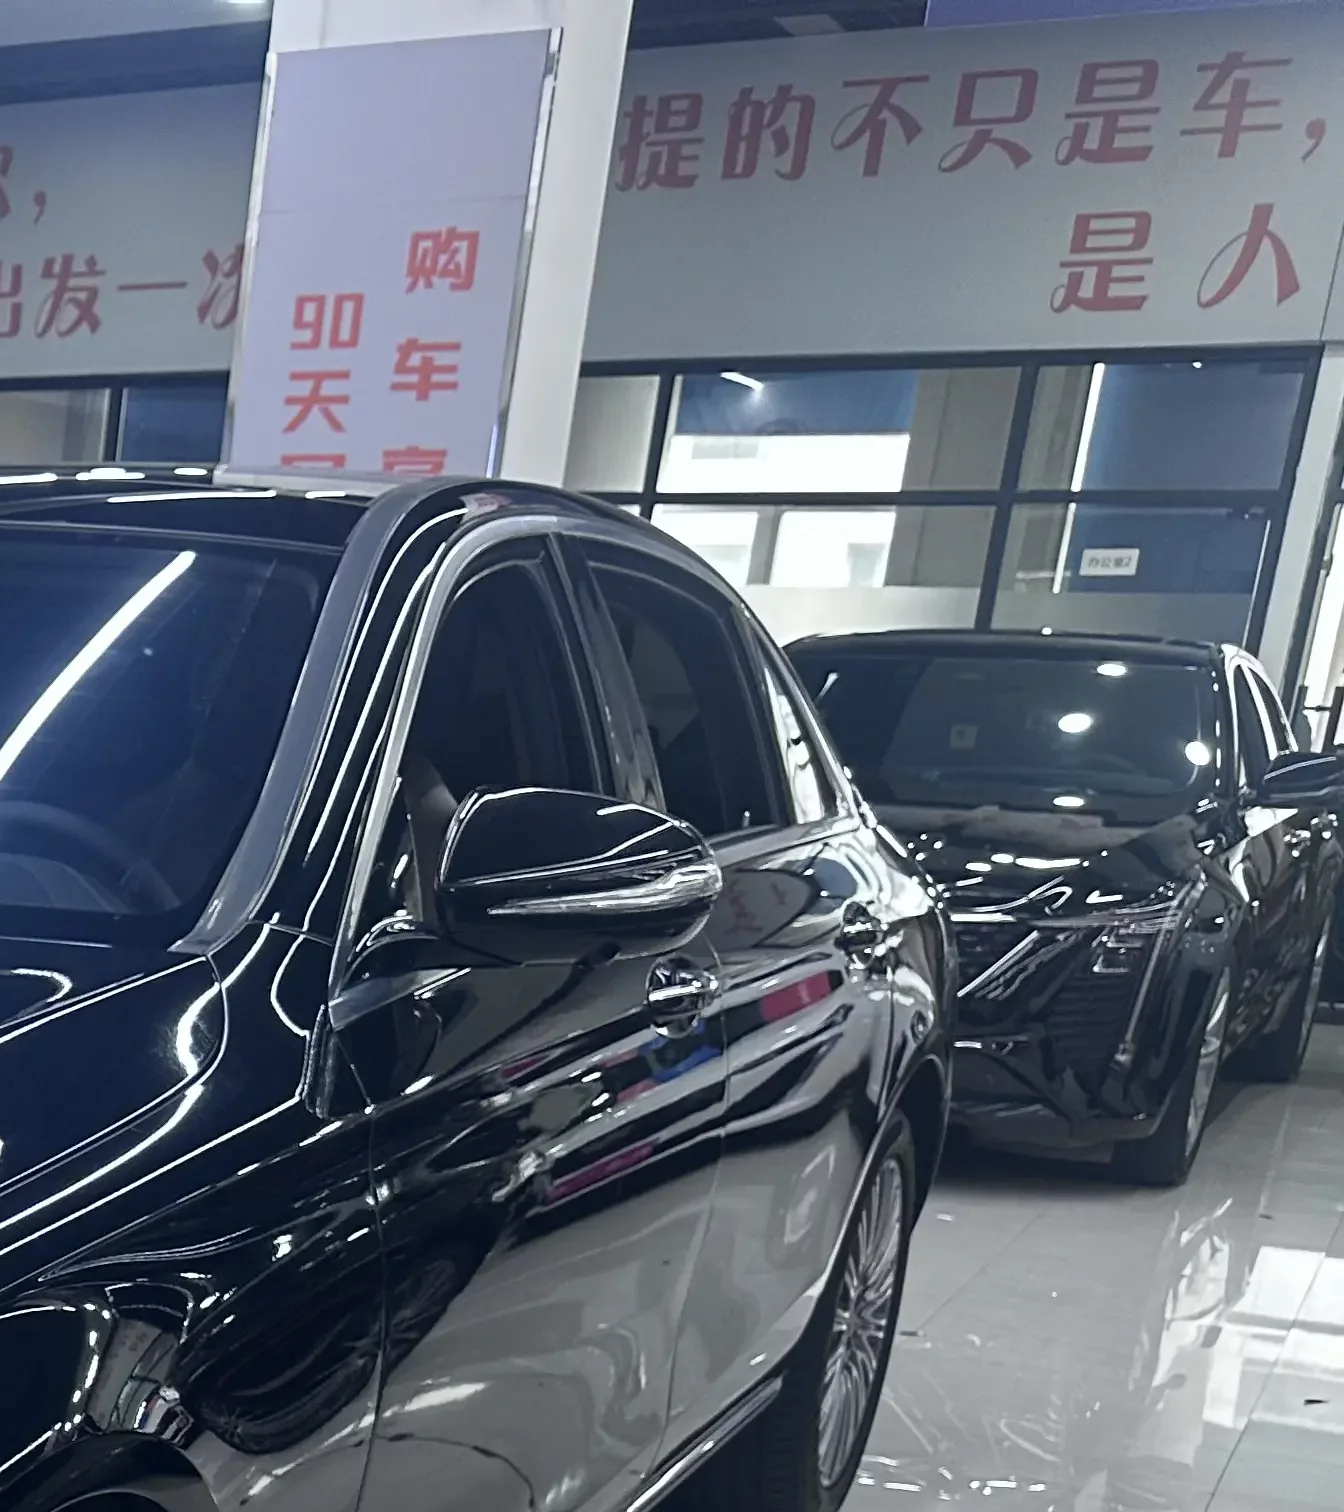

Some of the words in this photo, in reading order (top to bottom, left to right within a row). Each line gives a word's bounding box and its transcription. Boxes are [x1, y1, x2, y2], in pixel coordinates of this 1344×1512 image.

[614, 50, 1328, 192] 提的不只是车，
[1049, 203, 1301, 314] 是人
[280, 292, 365, 468] 90天
